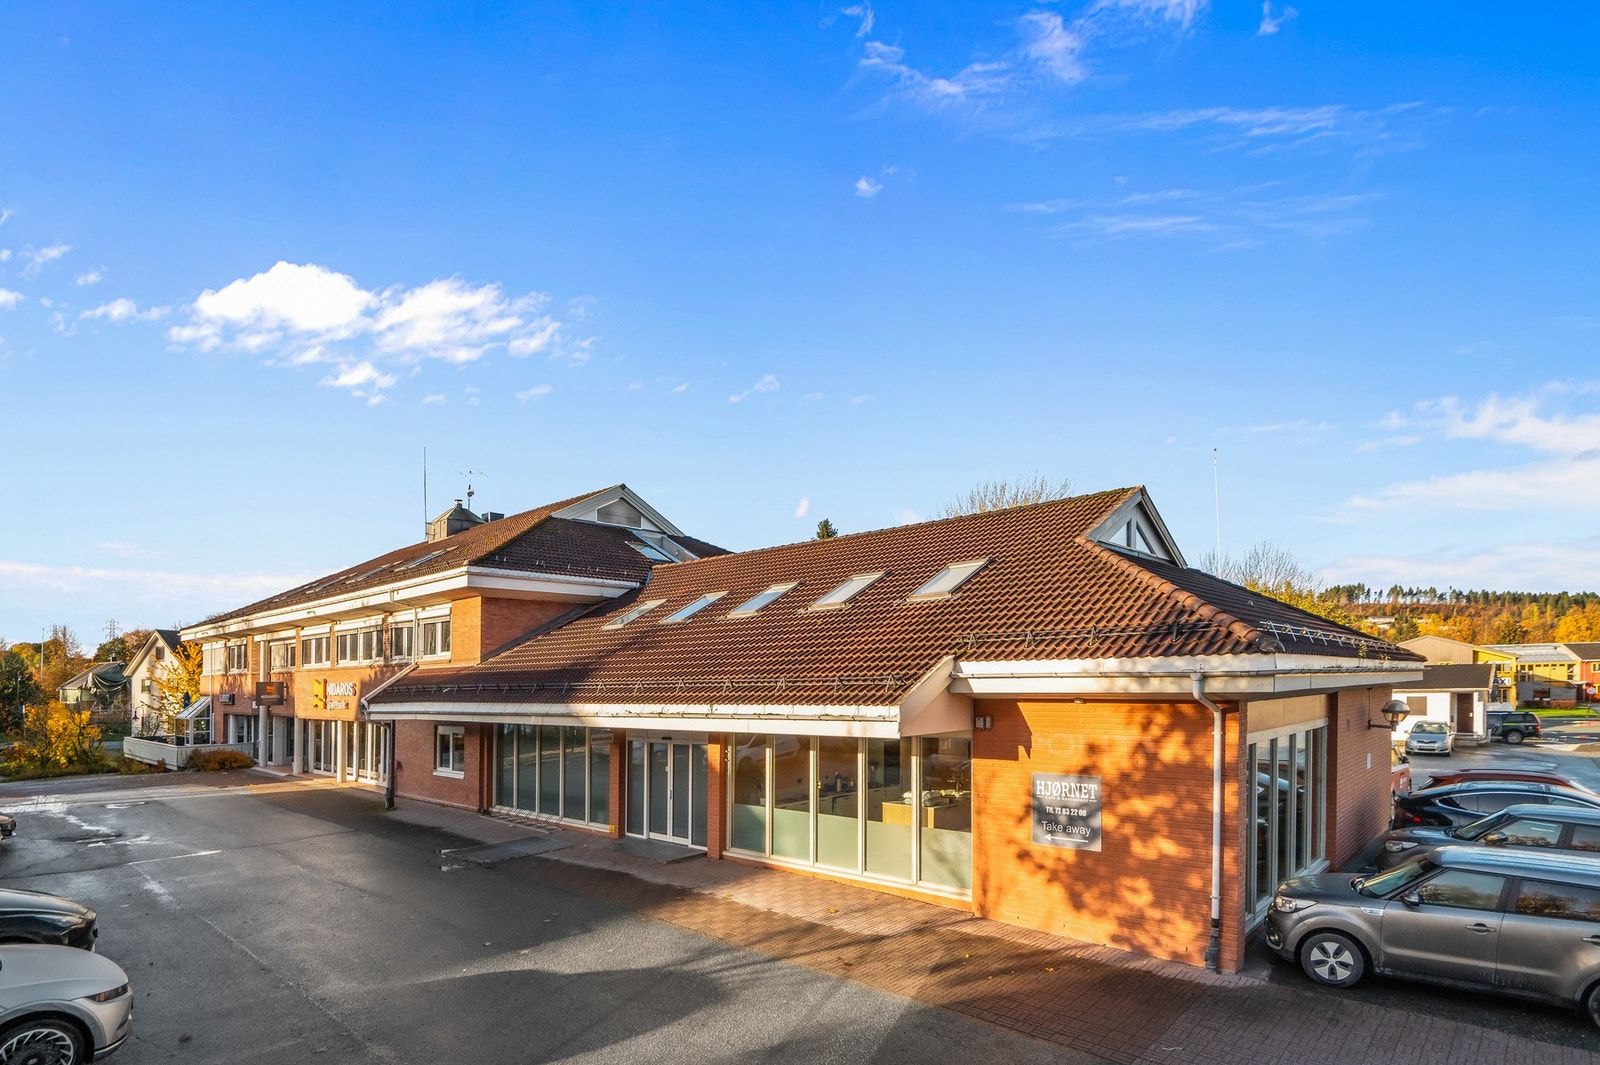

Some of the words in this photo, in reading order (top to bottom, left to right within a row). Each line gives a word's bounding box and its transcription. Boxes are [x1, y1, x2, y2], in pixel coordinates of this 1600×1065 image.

[326, 682, 353, 696] NIDAROS
[1036, 780, 1097, 799] HJØRNET
[1041, 820, 1064, 832] Take
[1065, 825, 1091, 837] away
